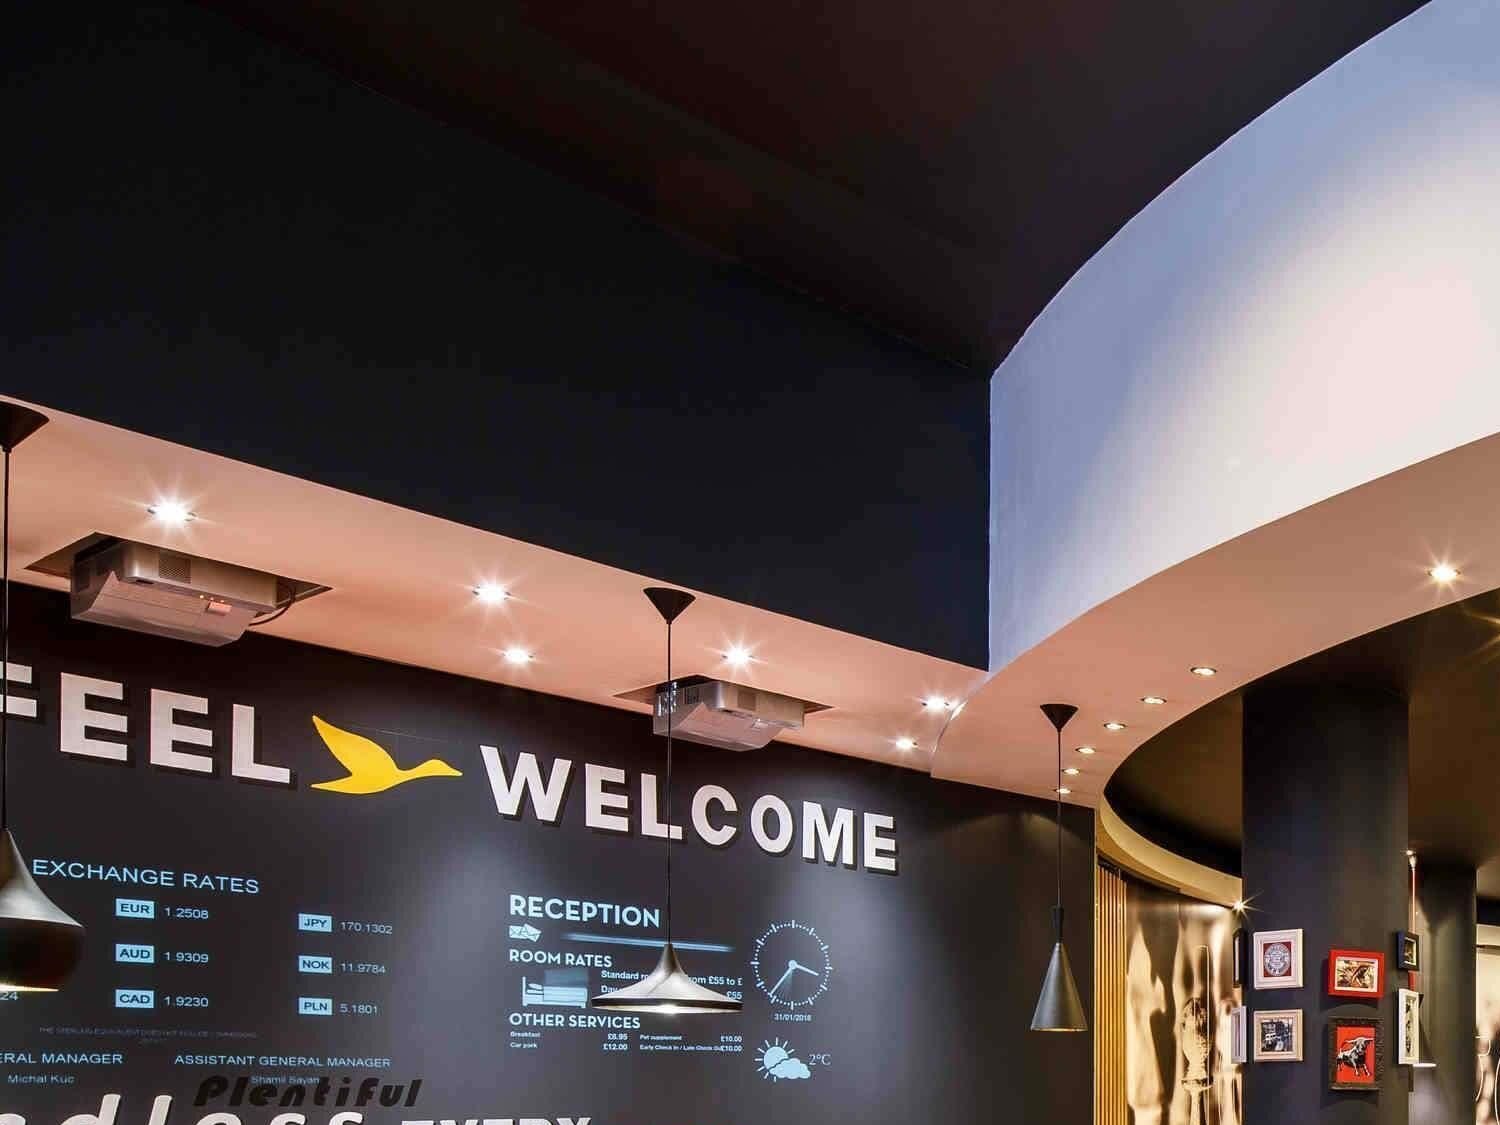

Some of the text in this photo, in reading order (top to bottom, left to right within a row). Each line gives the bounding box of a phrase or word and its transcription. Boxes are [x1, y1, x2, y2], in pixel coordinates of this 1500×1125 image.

[0, 661, 291, 784] FEEL
[480, 745, 897, 872] WELCOME
[33, 859, 260, 895] EXCHANGE RATES
[120, 902, 209, 920] EUR 1.2508
[509, 894, 660, 928] RECEPTION
[304, 917, 328, 929] JPY
[119, 948, 209, 964] AUD 1.9309
[509, 949, 612, 968] ROOM RATES
[302, 958, 329, 970] NOK
[601, 970, 639, 981] Standard
[709, 977, 724, 986] £55
[726, 978, 736, 986] to
[119, 993, 209, 1008] CAD 1.9230
[304, 1001, 328, 1012] PLN
[509, 1013, 640, 1029] OTHER SERVICES
[42, 1053, 123, 1065] MANAGER
[174, 1055, 392, 1068] ASSISTANT GENERAL MANAGER
[8, 1074, 47, 1084] Michal
[194, 1075, 423, 1107] Plentiful
